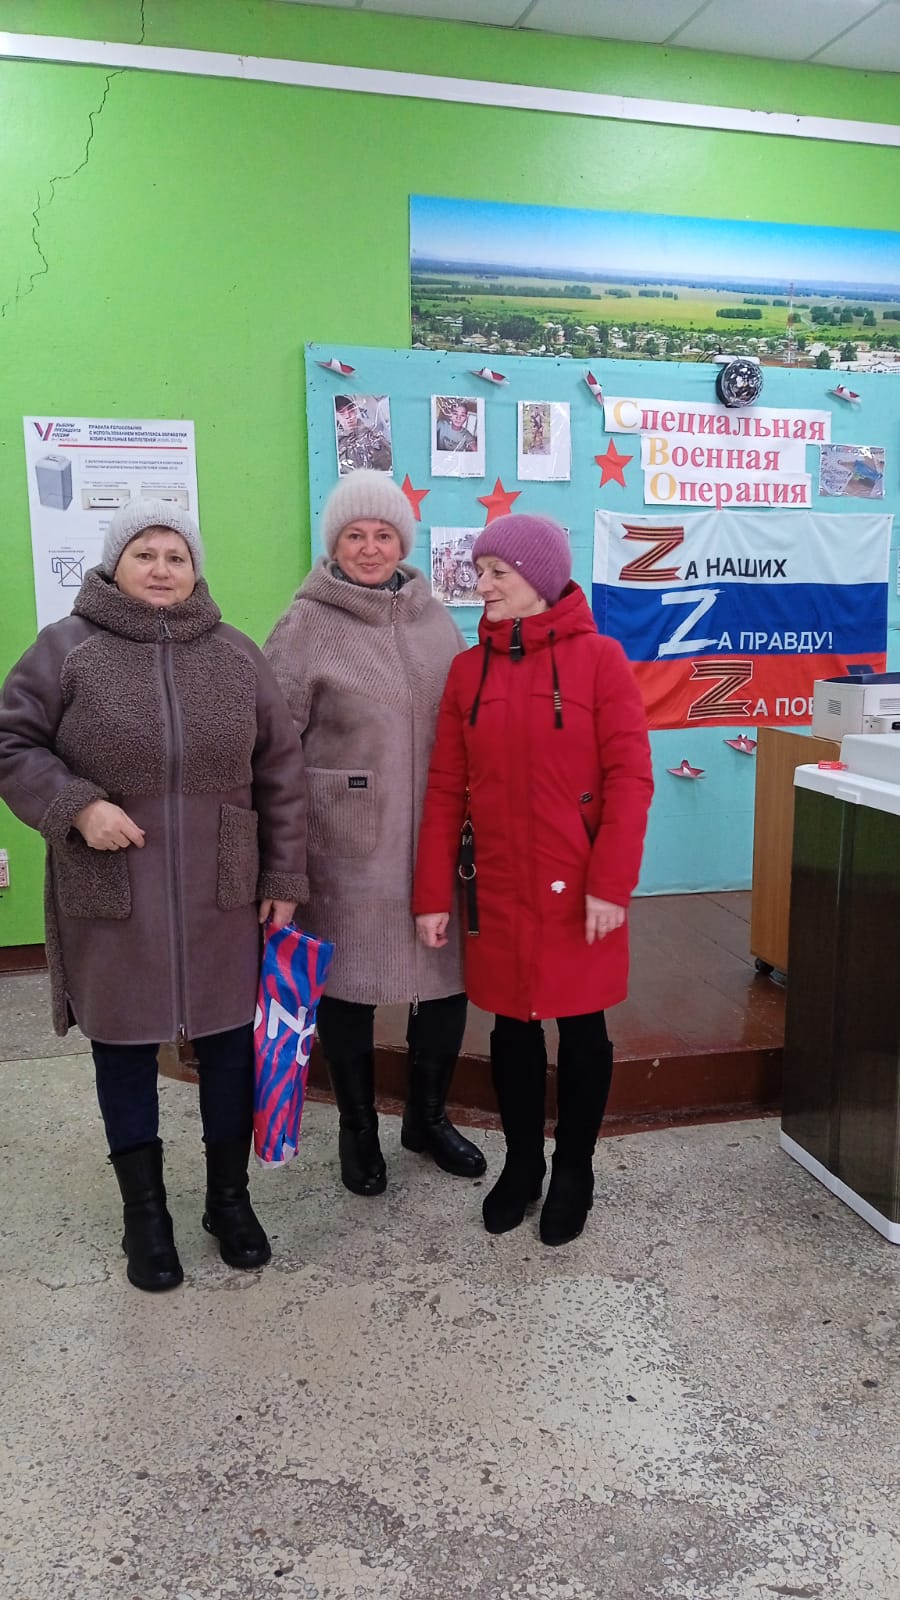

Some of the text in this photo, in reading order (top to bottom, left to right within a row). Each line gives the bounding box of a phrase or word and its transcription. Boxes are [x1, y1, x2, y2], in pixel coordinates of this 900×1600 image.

[613, 400, 825, 440] Специальная
[647, 437, 780, 471] Военная
[650, 472, 807, 510] Операция
[706, 557, 788, 578] НАШИХ
[739, 631, 833, 653] ПРАВДУ!
